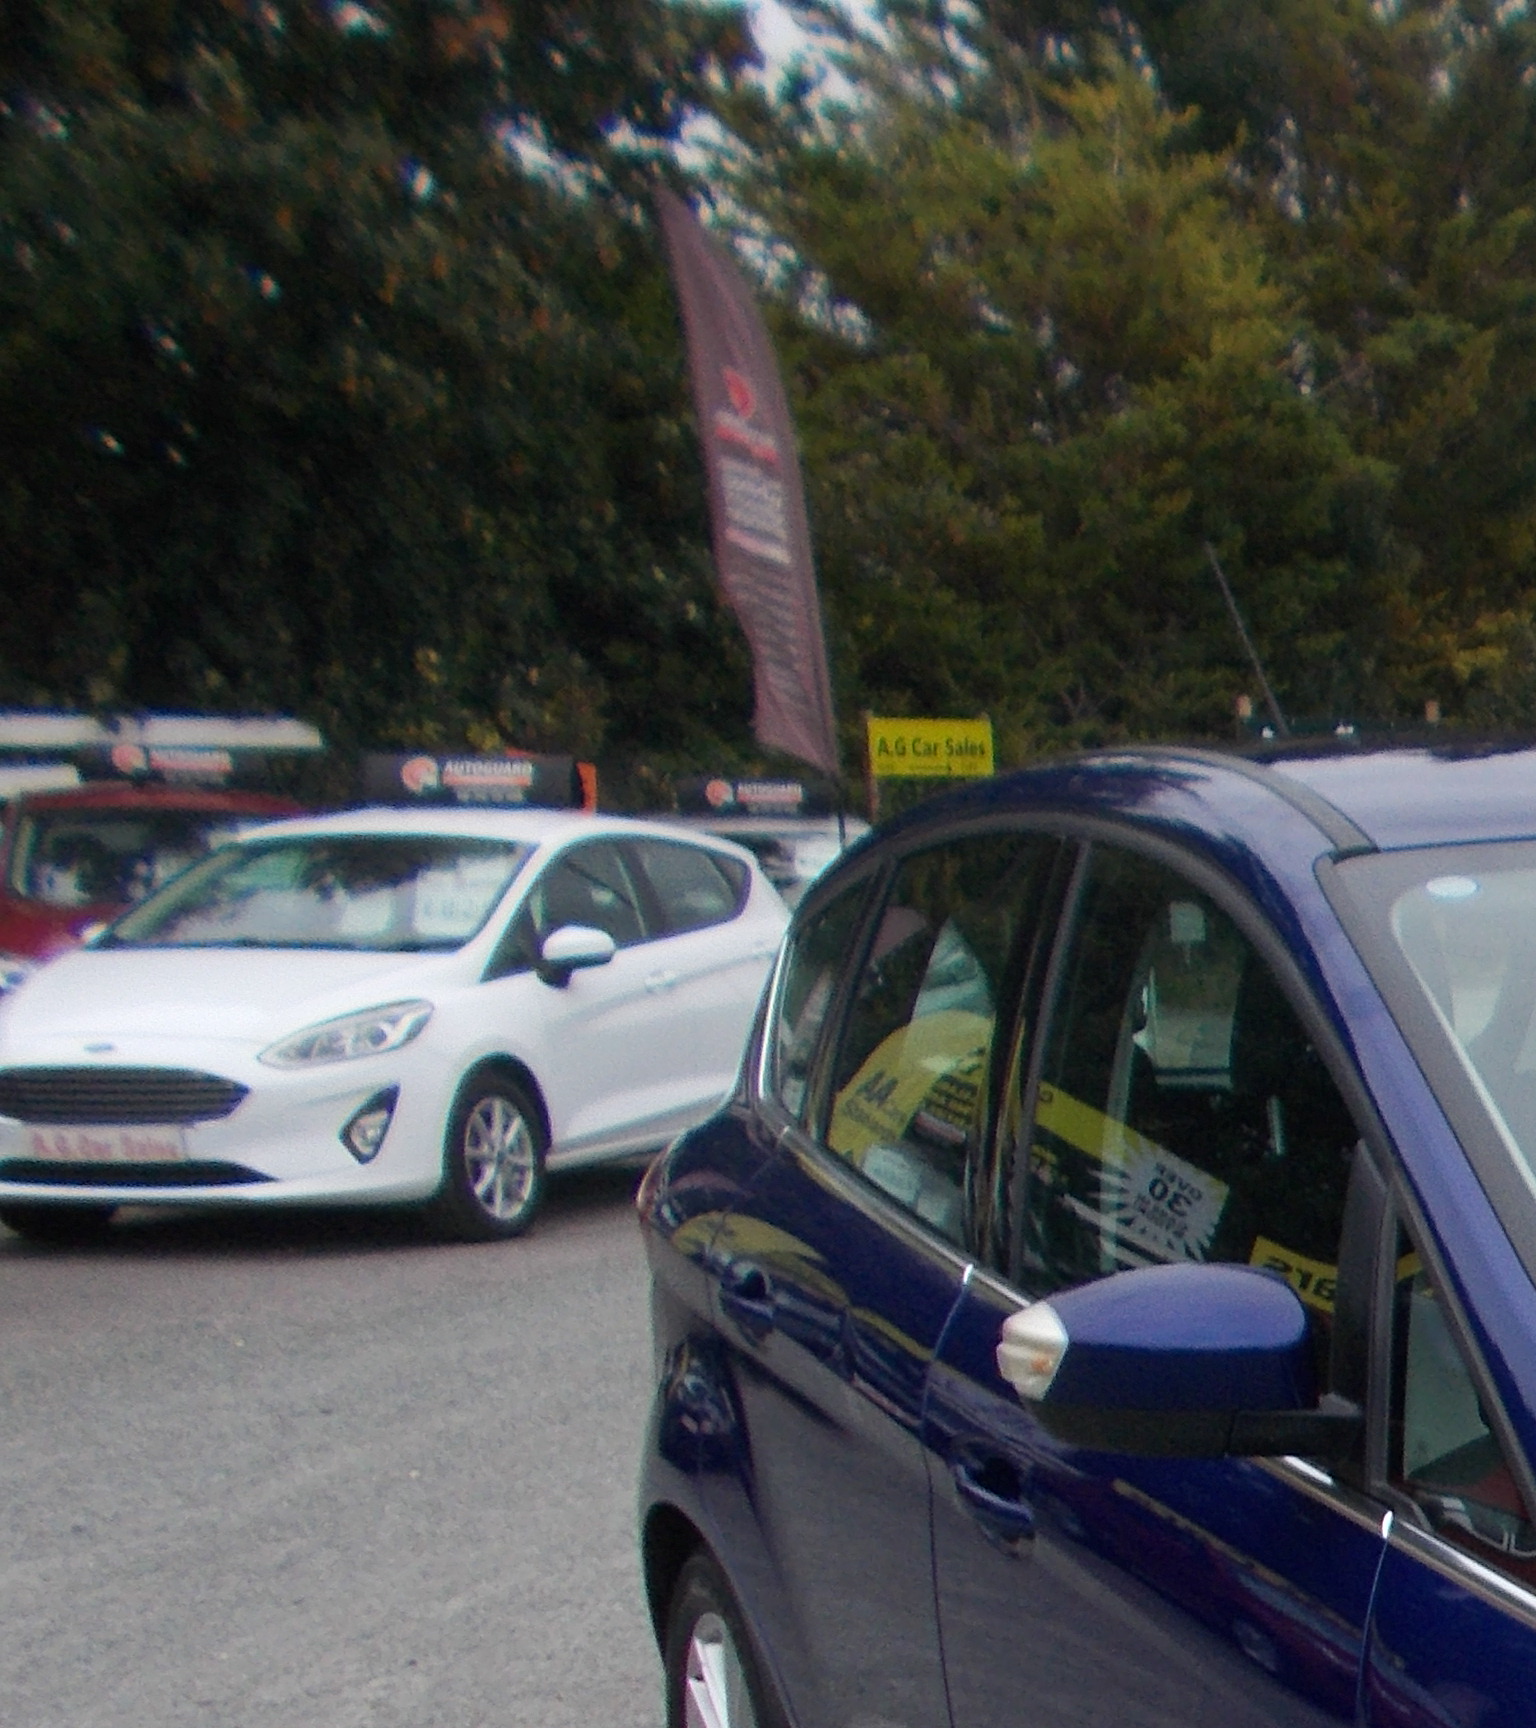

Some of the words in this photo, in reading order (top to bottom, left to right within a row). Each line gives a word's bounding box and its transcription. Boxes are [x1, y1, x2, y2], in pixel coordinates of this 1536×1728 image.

[911, 736, 938, 756] Car
[944, 735, 985, 756] Sales
[444, 760, 533, 777] AUTOGUARD
